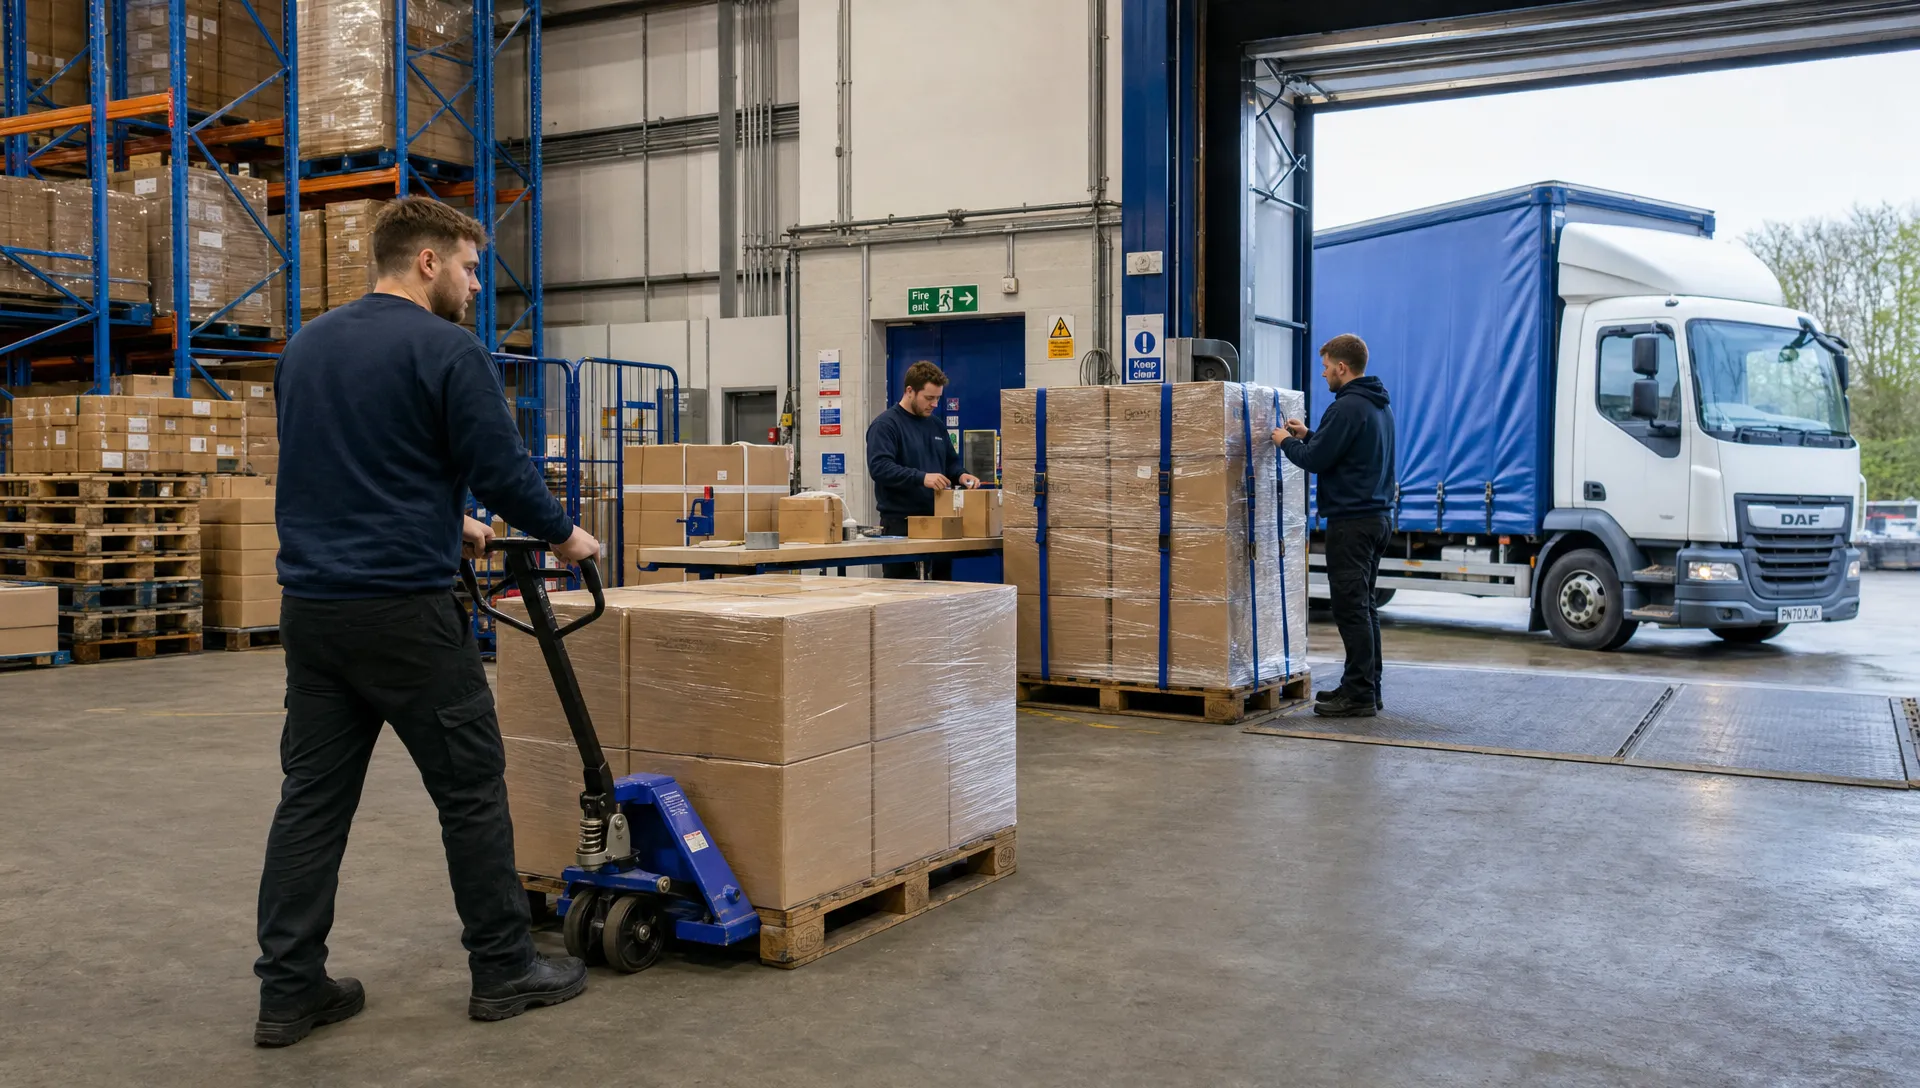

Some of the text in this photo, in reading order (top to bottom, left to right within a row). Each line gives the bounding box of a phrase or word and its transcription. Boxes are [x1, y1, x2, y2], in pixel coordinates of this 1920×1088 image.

[912, 291, 929, 300] Fire
[912, 302, 929, 311] exit
[1133, 360, 1156, 370] Keep
[1133, 370, 1156, 378] clear
[1781, 514, 1819, 525] DAF
[1781, 607, 1819, 620] PN70 XJK
